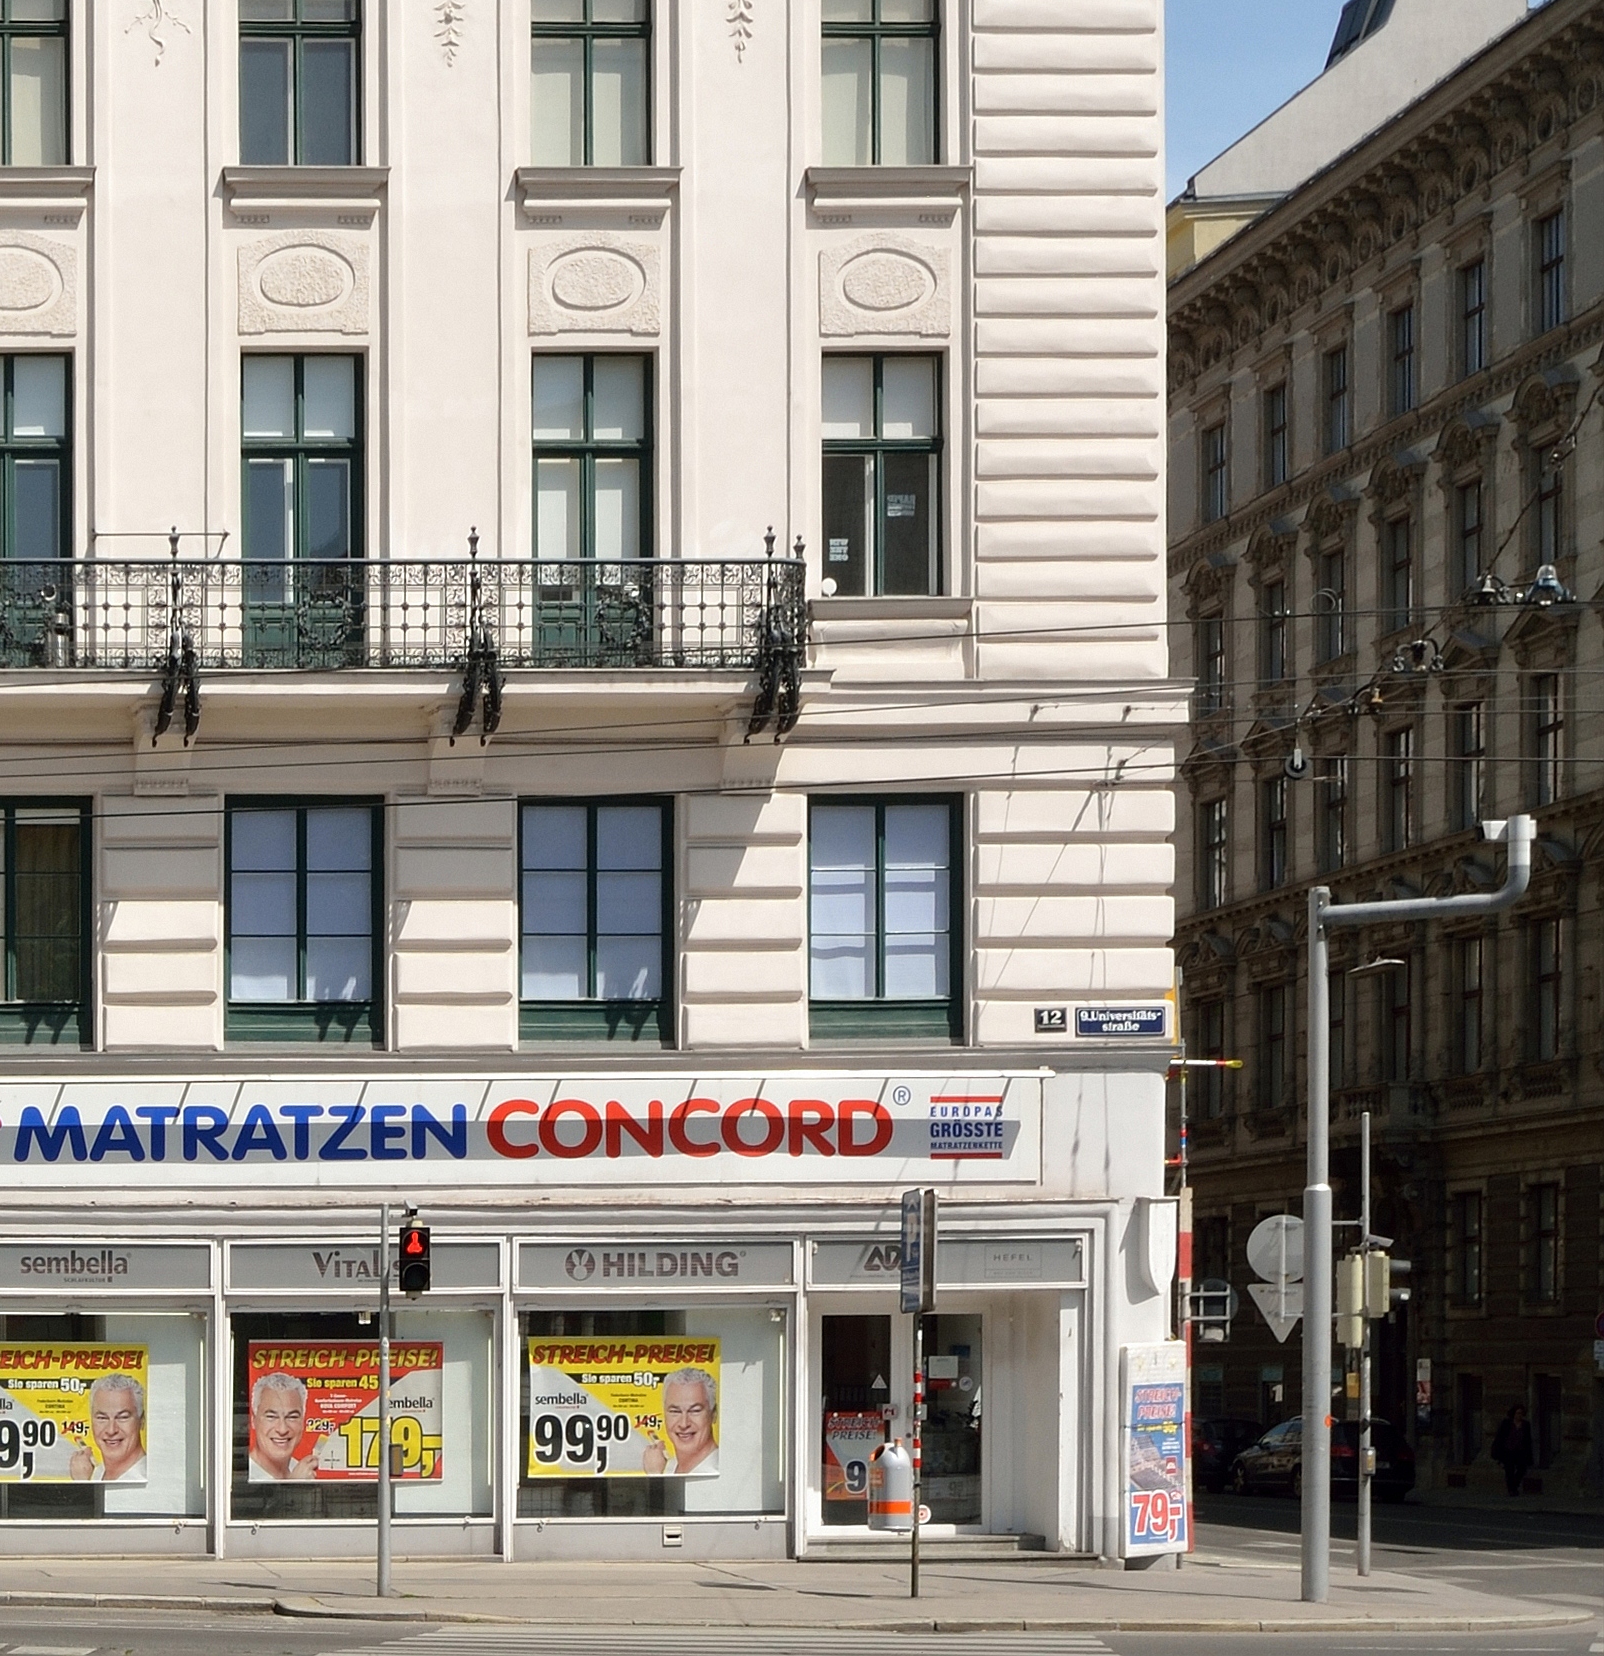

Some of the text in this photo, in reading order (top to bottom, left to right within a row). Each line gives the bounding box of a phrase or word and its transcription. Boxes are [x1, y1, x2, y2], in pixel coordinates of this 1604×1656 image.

[1040, 1010, 1062, 1025] 12
[1101, 1021, 1140, 1032] straße
[930, 1106, 1003, 1117] EUROPAS
[14, 1098, 894, 1163] MATRATZEN CONCORD
[930, 1119, 1003, 1138] GRÖSSTE
[20, 1250, 128, 1275] sembella
[602, 1252, 739, 1278] HILDING
[993, 1254, 1033, 1262] HEFEL
[532, 1344, 715, 1364] STREICH-PREISE!
[7, 1378, 24, 1389] Sie
[26, 1379, 58, 1392] sparen
[306, 1377, 323, 1388] Sie
[324, 1378, 358, 1391] sparen
[581, 1373, 598, 1384] Sie
[599, 1374, 632, 1386] sparen
[388, 1396, 434, 1410] embella
[535, 1392, 587, 1406] sembella
